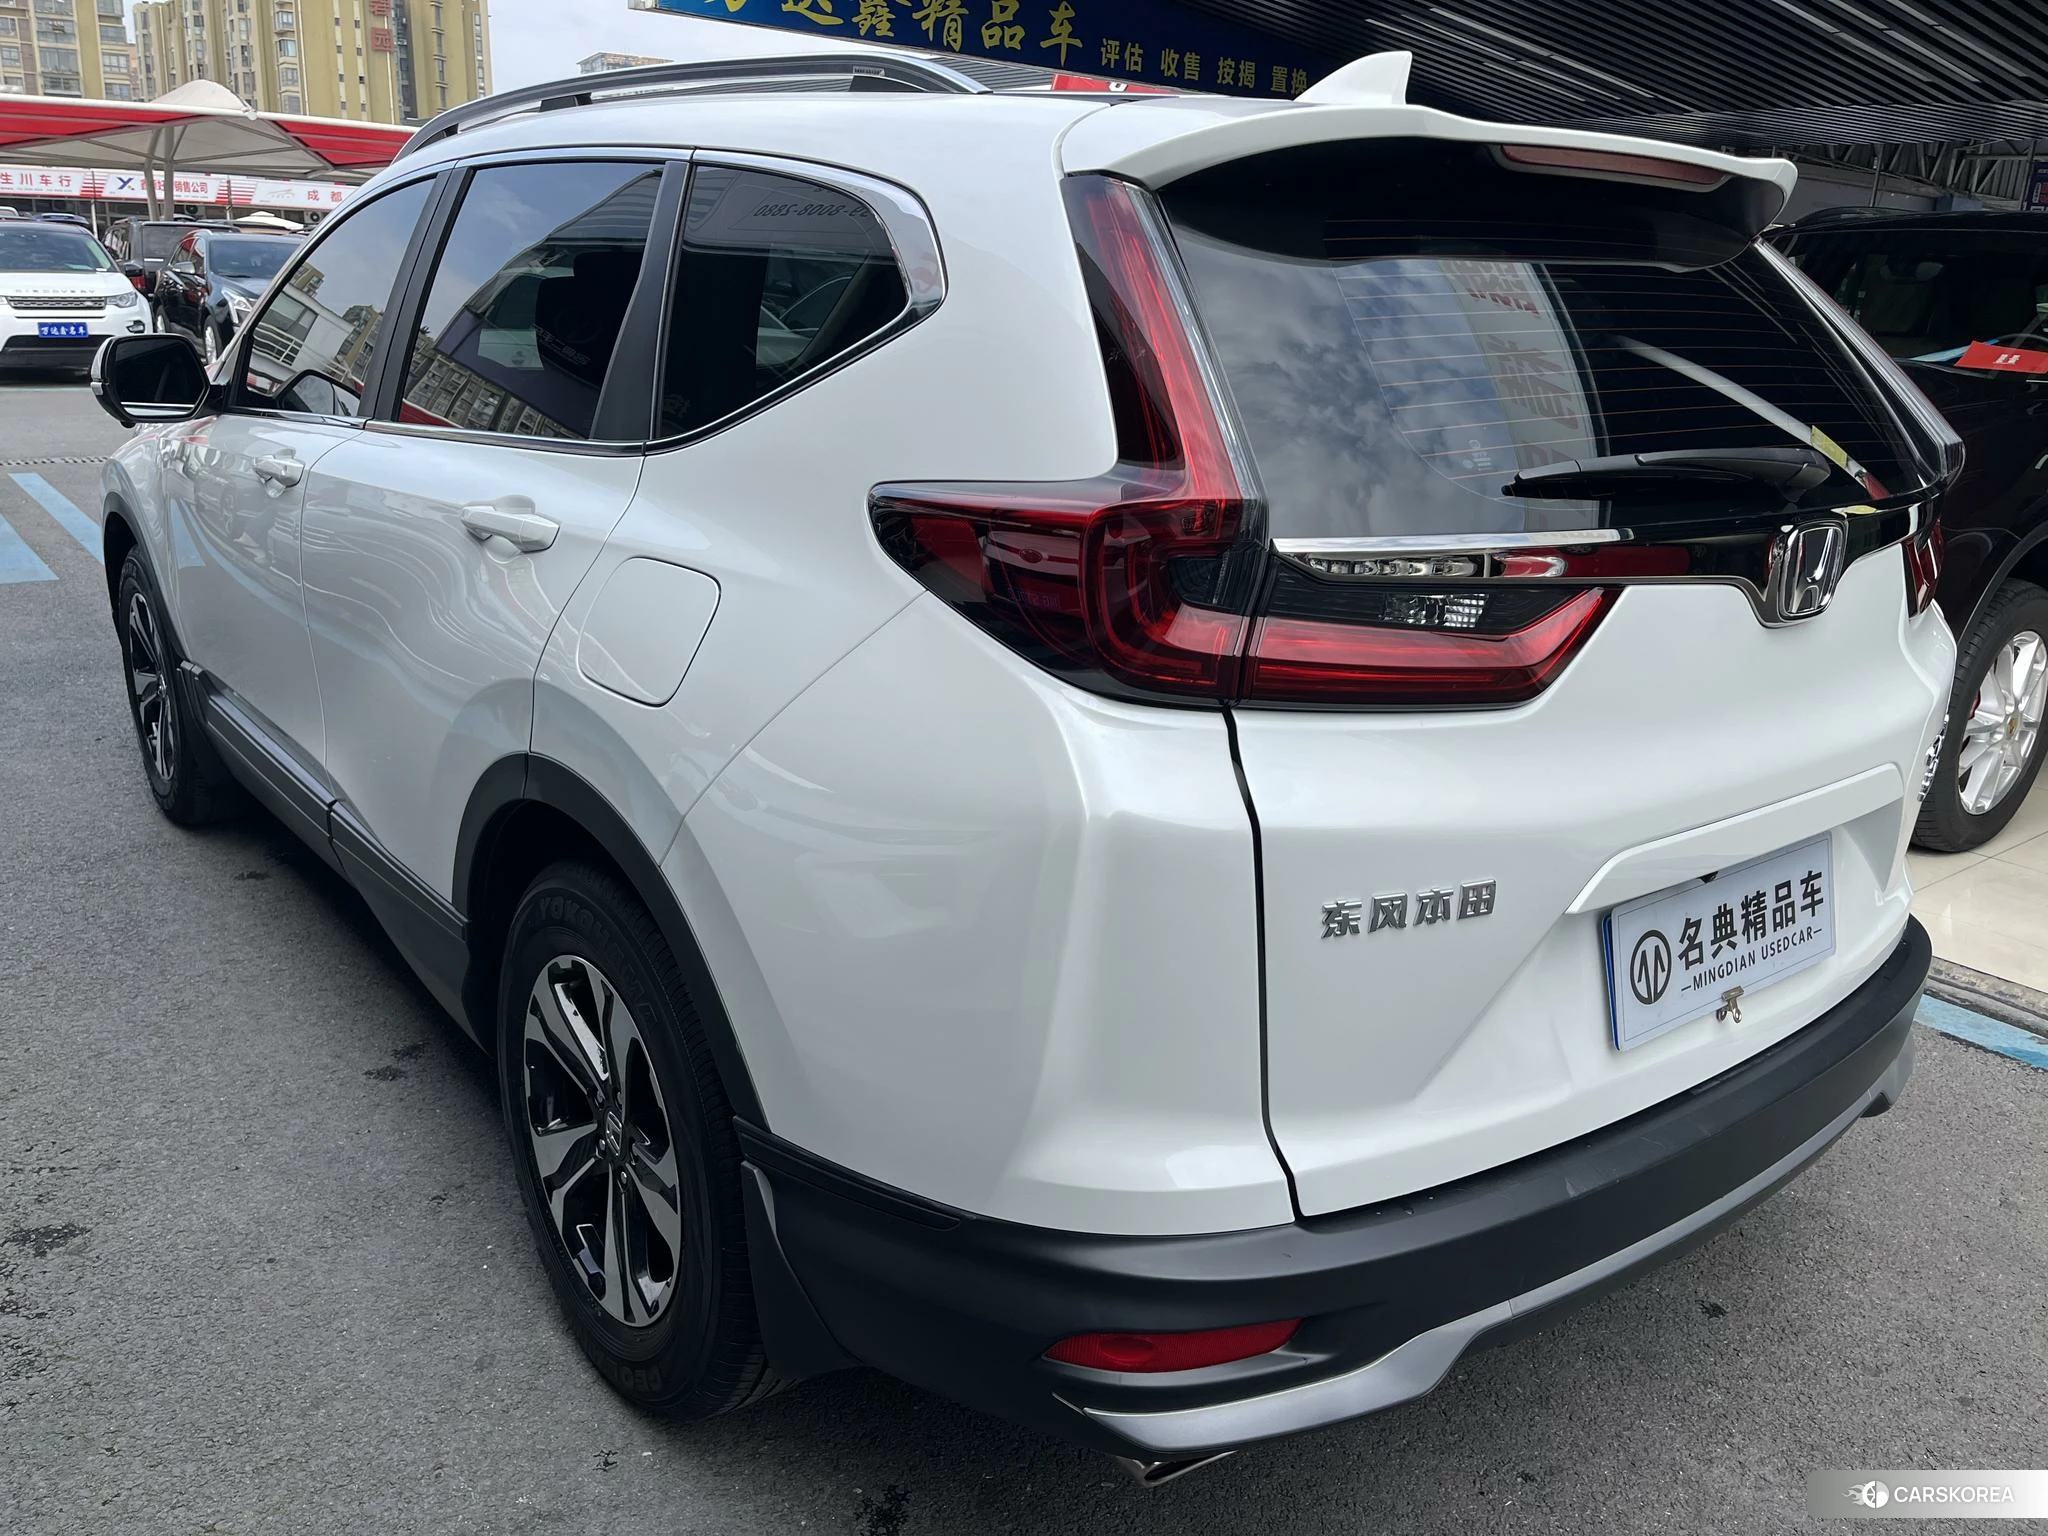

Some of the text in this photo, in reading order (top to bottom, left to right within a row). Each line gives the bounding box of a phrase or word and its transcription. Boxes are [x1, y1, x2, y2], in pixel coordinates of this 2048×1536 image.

[703, 0, 1083, 66] 鑫精品车
[1100, 37, 1308, 95] 评估 收售 按揭 置换
[1, 172, 72, 187] 生川车行
[307, 190, 342, 204] 成都
[1321, 879, 1496, 939] 东风本田
[1678, 870, 1824, 971] 名典精品车
